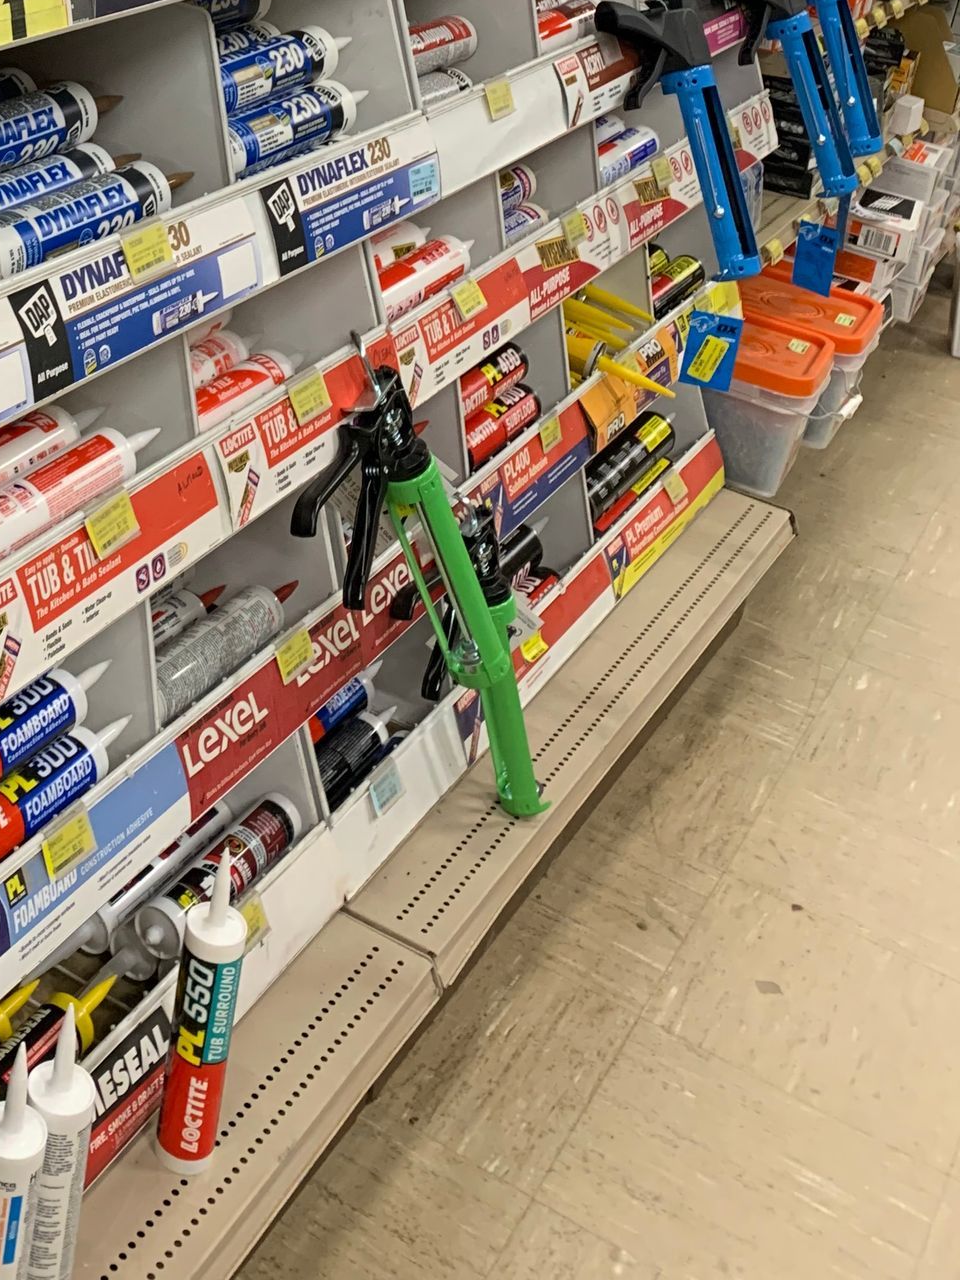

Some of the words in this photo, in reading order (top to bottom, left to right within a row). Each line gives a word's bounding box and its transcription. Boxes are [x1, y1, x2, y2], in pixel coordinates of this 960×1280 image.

[270, 44, 304, 77] 230
[284, 93, 321, 123] 230
[297, 149, 370, 198] DYNAFLEX
[368, 138, 391, 163] 230
[39, 183, 131, 238] DYNAFLEX
[630, 202, 663, 233] ALL-PURPOSE
[530, 272, 572, 307] ALL-PURPOSE
[499, 349, 520, 372] 400
[639, 338, 662, 361] PRO
[261, 415, 285, 444] TUB
[469, 423, 498, 449] LOCTITE
[503, 450, 530, 481] PL400
[27, 563, 61, 607] TUB
[61, 554, 75, 585] &
[0, 693, 72, 754] FOAMBOARD
[36, 735, 81, 778] 300
[23, 758, 94, 823] FOAMBOARD
[187, 960, 215, 1026] 550
[211, 965, 236, 1033] SURROUND
[176, 1028, 203, 1068] PL
[206, 1032, 223, 1062] TUB
[89, 1128, 108, 1154] FIRE,
[108, 1107, 133, 1134] SMOKE
[180, 1076, 209, 1155] LOCTITE
